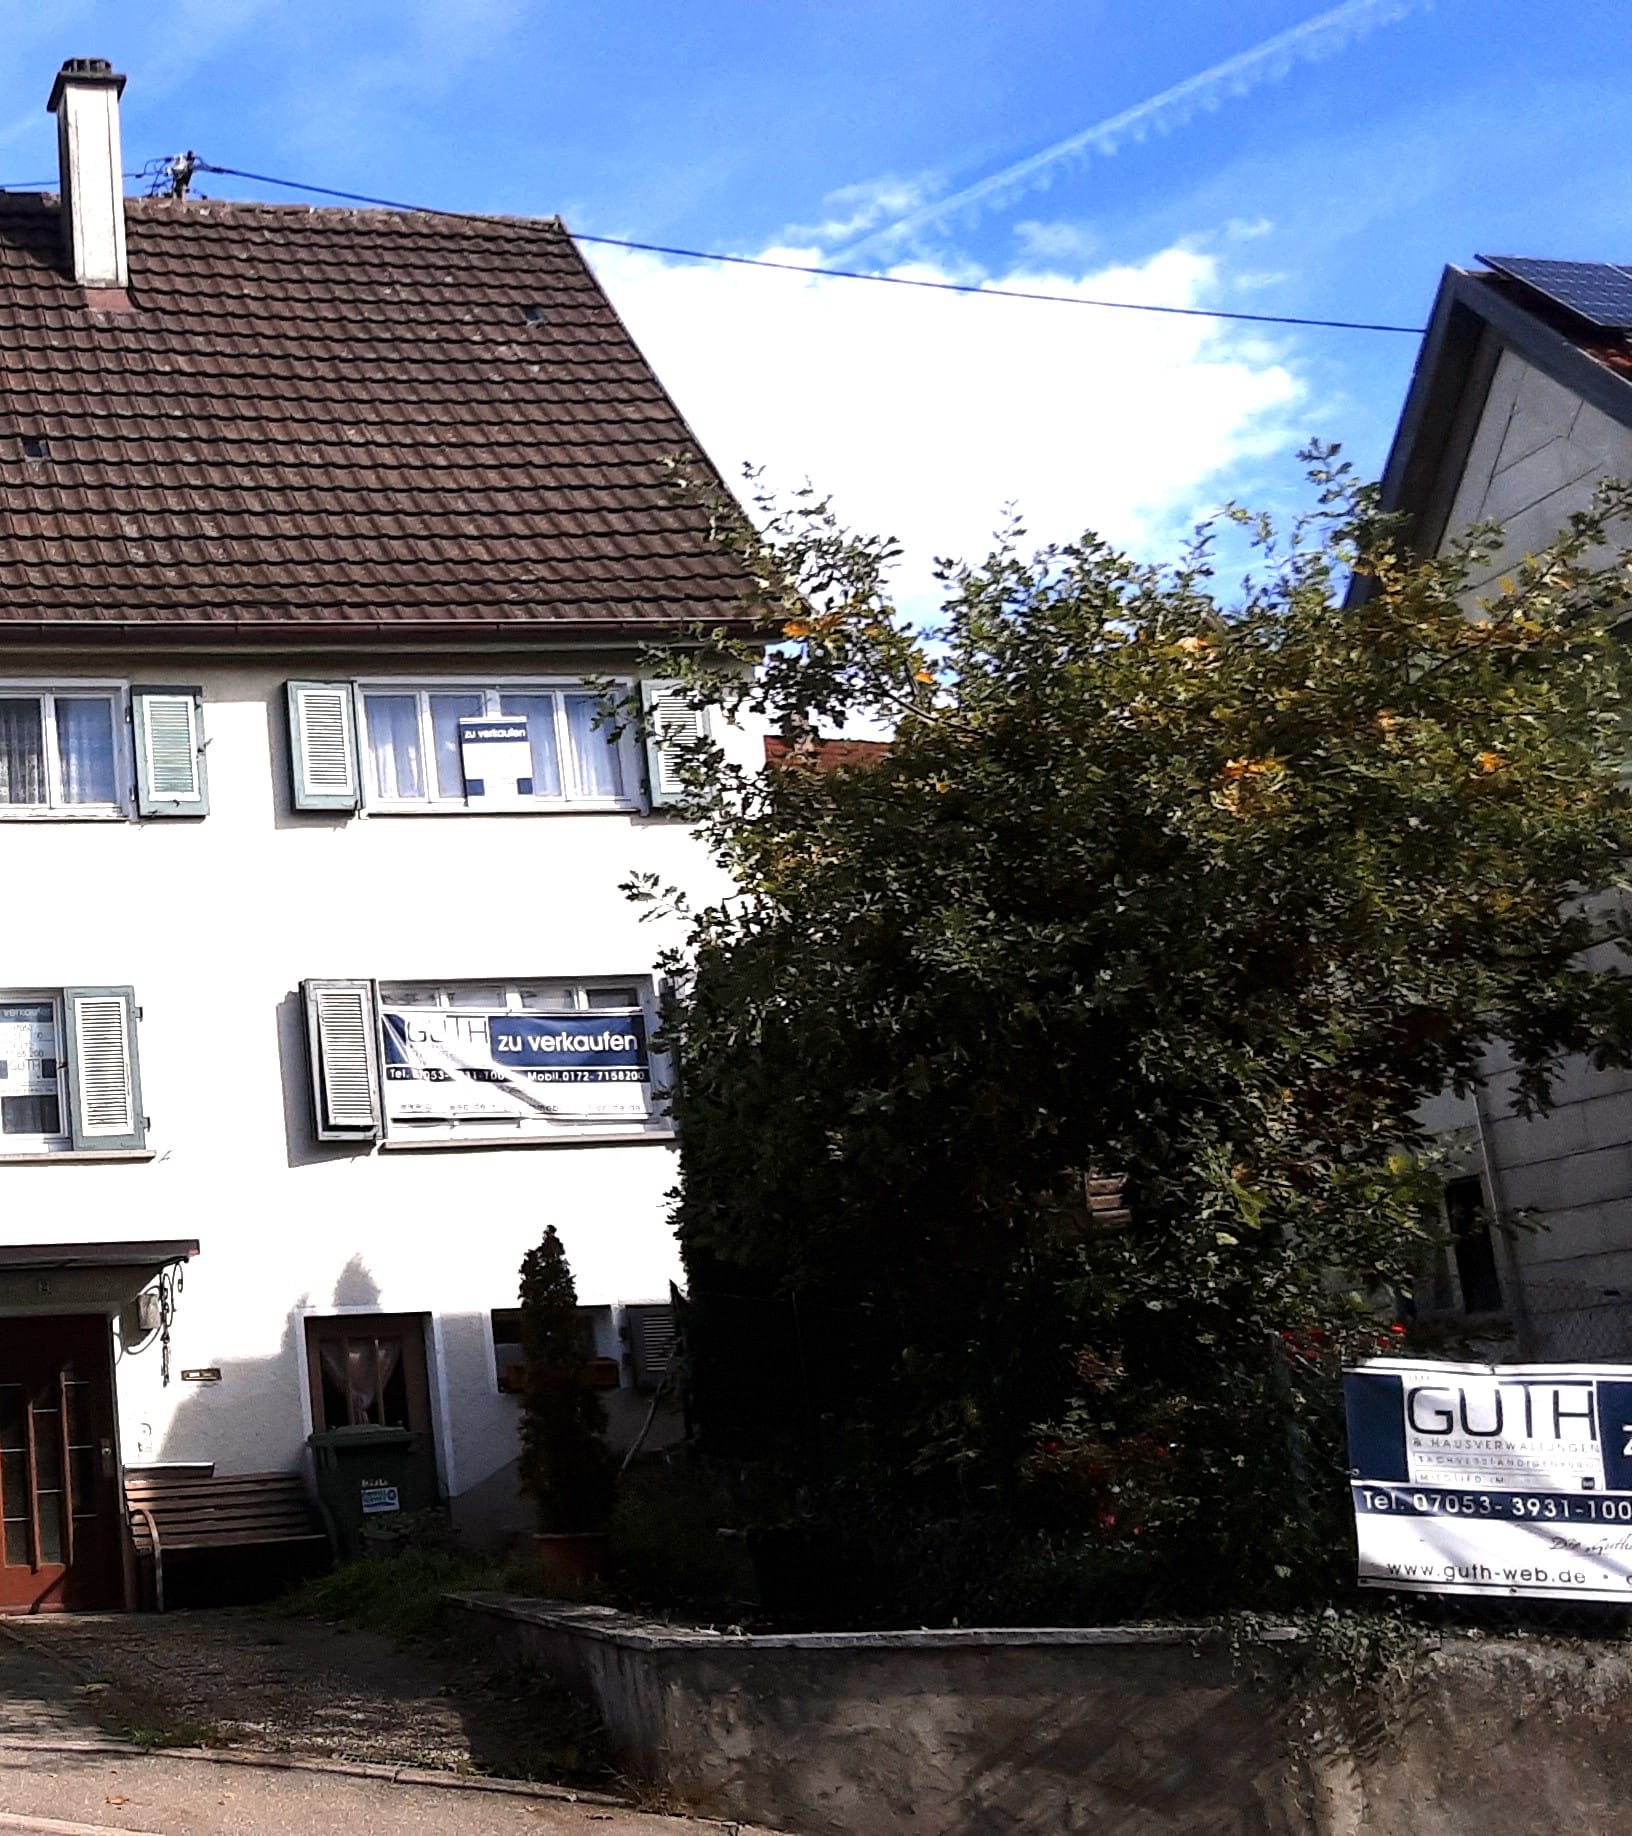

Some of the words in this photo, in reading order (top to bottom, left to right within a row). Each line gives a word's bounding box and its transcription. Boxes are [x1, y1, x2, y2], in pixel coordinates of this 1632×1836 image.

[464, 730, 476, 739] zu
[477, 727, 526, 738] verkaufen
[498, 1034, 522, 1052] zu
[527, 1031, 638, 1052] verkaufen
[389, 1068, 410, 1079] Tel.
[1407, 1381, 1597, 1441] GUTH
[1362, 1491, 1405, 1511] Tel.
[1386, 1562, 1586, 1584] www.guth-web.de
